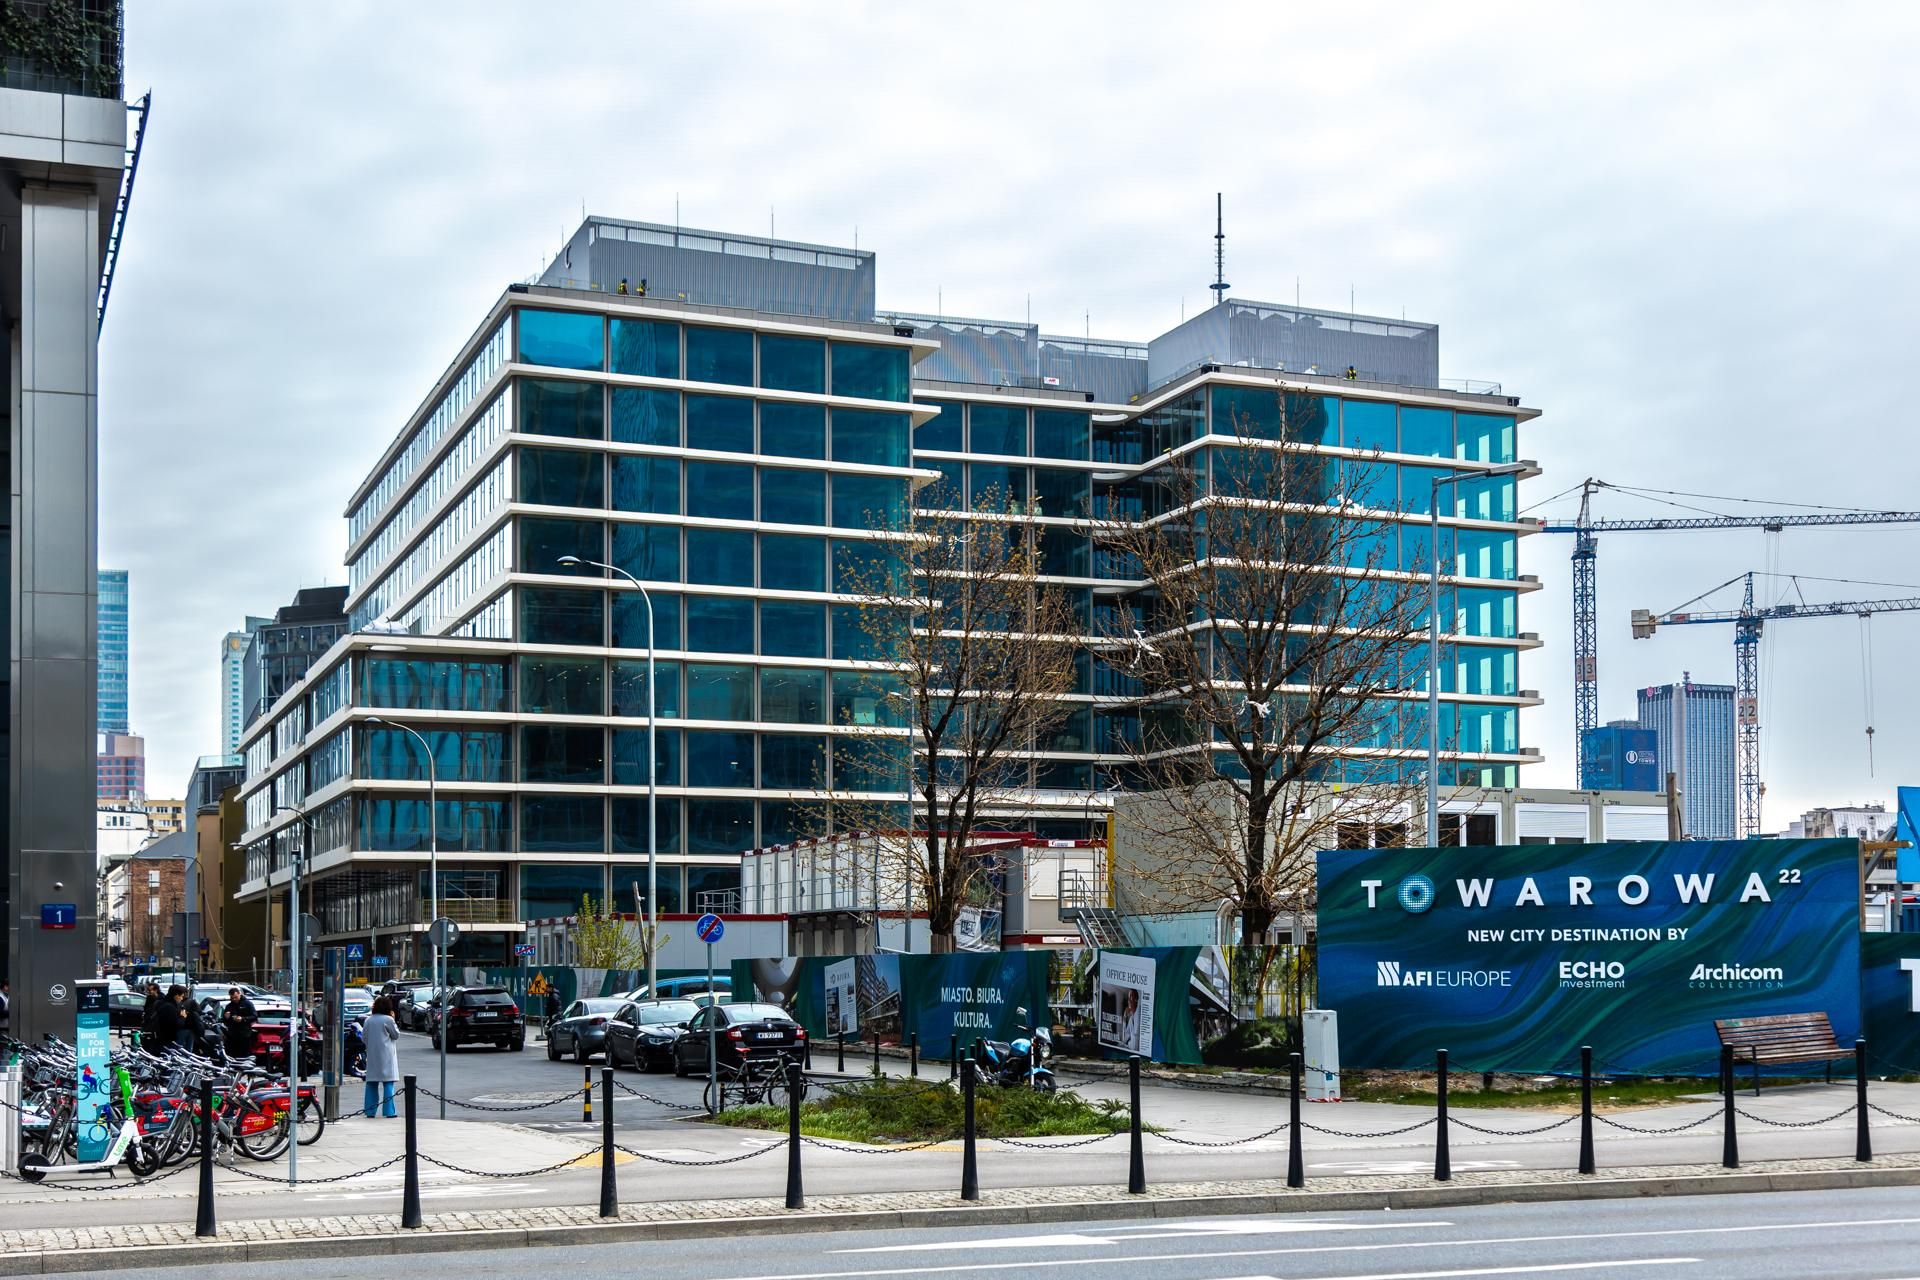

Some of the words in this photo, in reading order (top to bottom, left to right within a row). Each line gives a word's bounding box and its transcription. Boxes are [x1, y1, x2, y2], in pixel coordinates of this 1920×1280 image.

[1586, 663, 1592, 673] 3
[1748, 705, 1756, 716] 2
[1360, 872, 1772, 914] TOWAROWA
[1778, 868, 1802, 884] 22
[56, 910, 62, 923] 1
[1467, 929, 1504, 942] NEW
[1510, 929, 1546, 942] CITY
[1551, 928, 1661, 942] DESTINATION
[1667, 928, 1688, 941] BY
[516, 945, 536, 956] TAXI
[373, 956, 387, 966] TAXI
[1106, 968, 1127, 981] OFFICE
[1127, 973, 1148, 985] HOUSE
[1559, 961, 1625, 979] ECHO
[1689, 963, 1783, 980] Archicom
[1402, 971, 1432, 987] AFI
[1436, 970, 1512, 987] EUROPE
[1559, 979, 1625, 989] investment
[941, 986, 975, 1003] MIASTO.
[976, 987, 1004, 1004] BIURA.
[953, 1011, 993, 1028] KULTURA.
[80, 1031, 97, 1039] BIKE
[81, 1047, 106, 1057] LIFE
